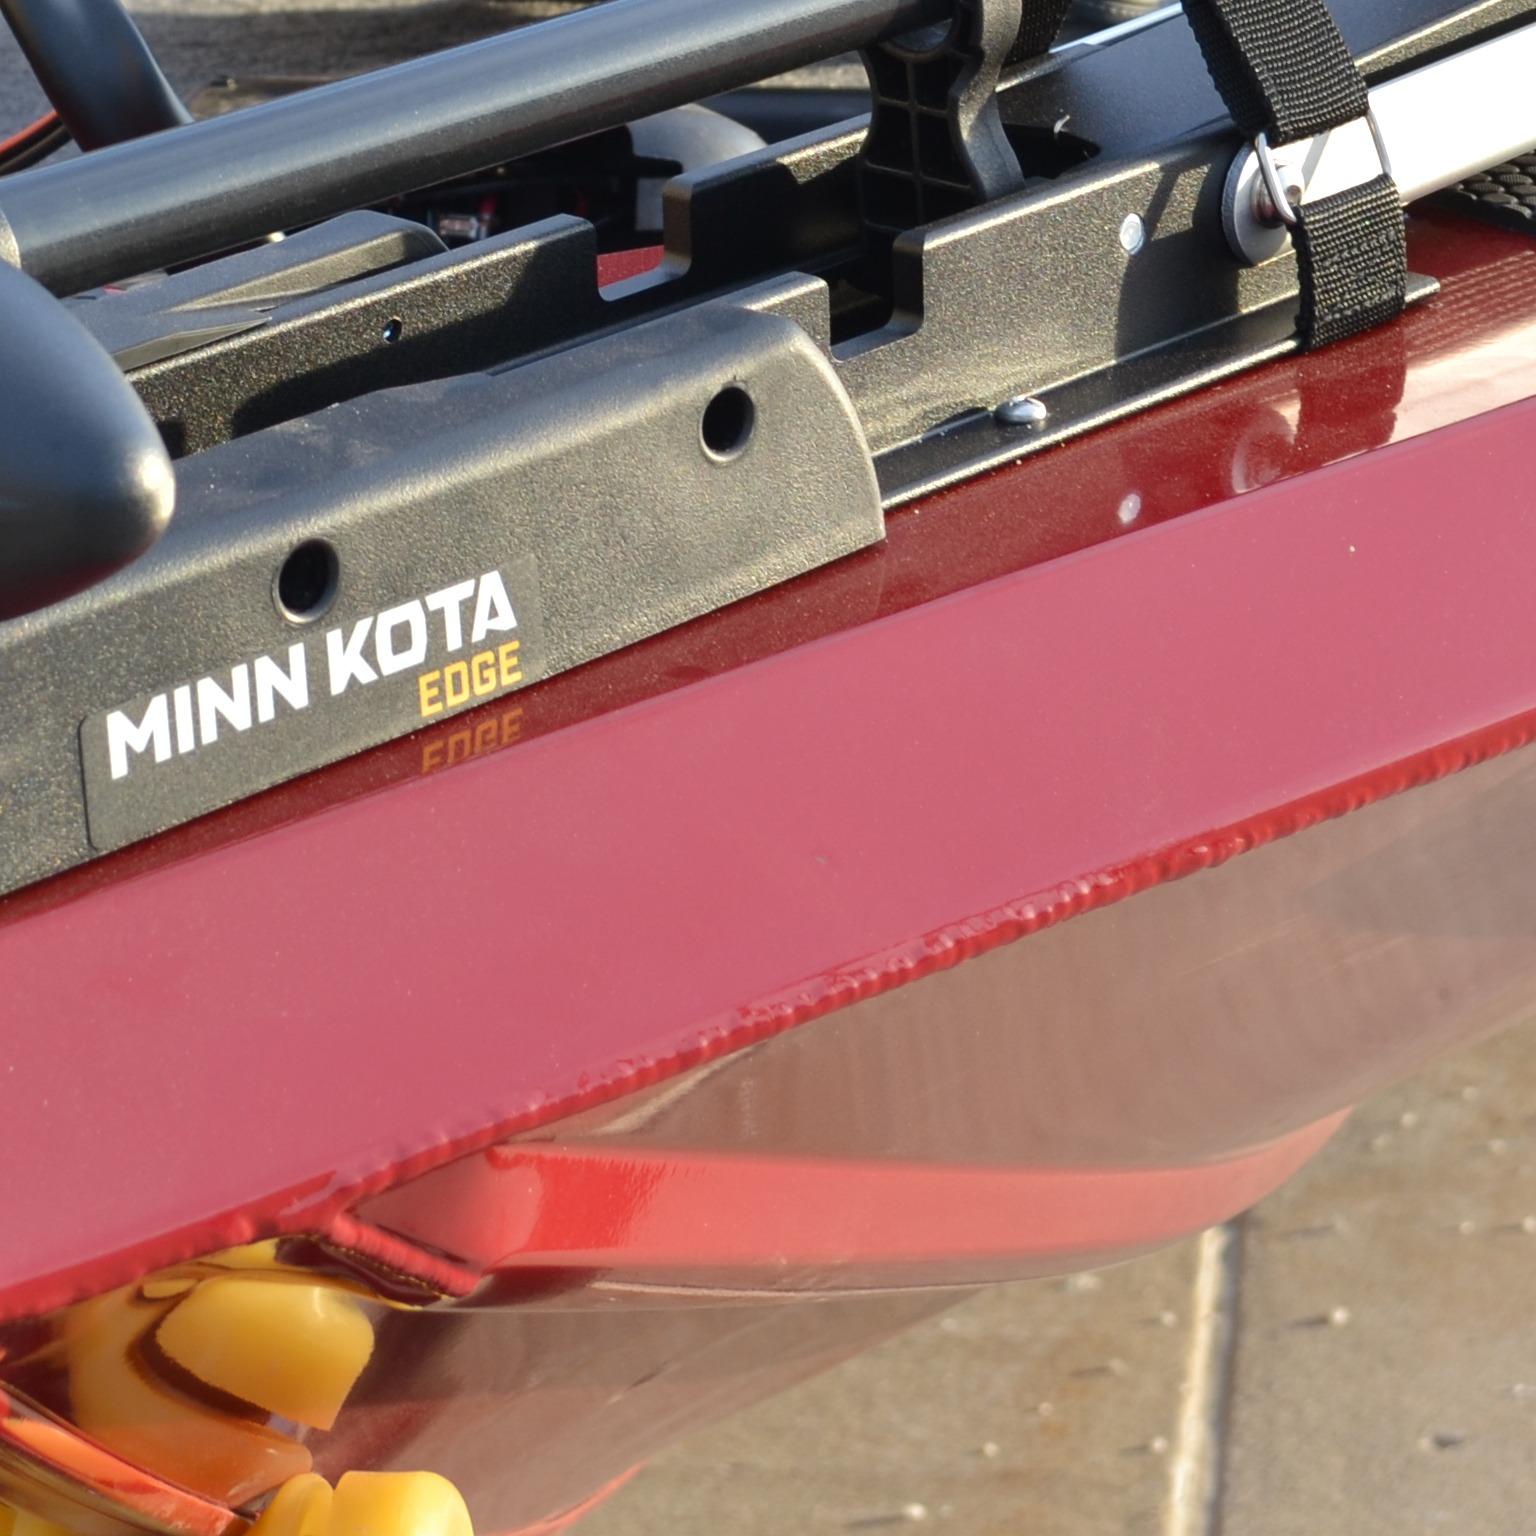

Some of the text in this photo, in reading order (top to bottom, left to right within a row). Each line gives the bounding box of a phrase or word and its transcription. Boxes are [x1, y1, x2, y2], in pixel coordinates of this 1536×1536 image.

[106, 569, 519, 780] MINN KOTA
[418, 639, 523, 718] EDGE
